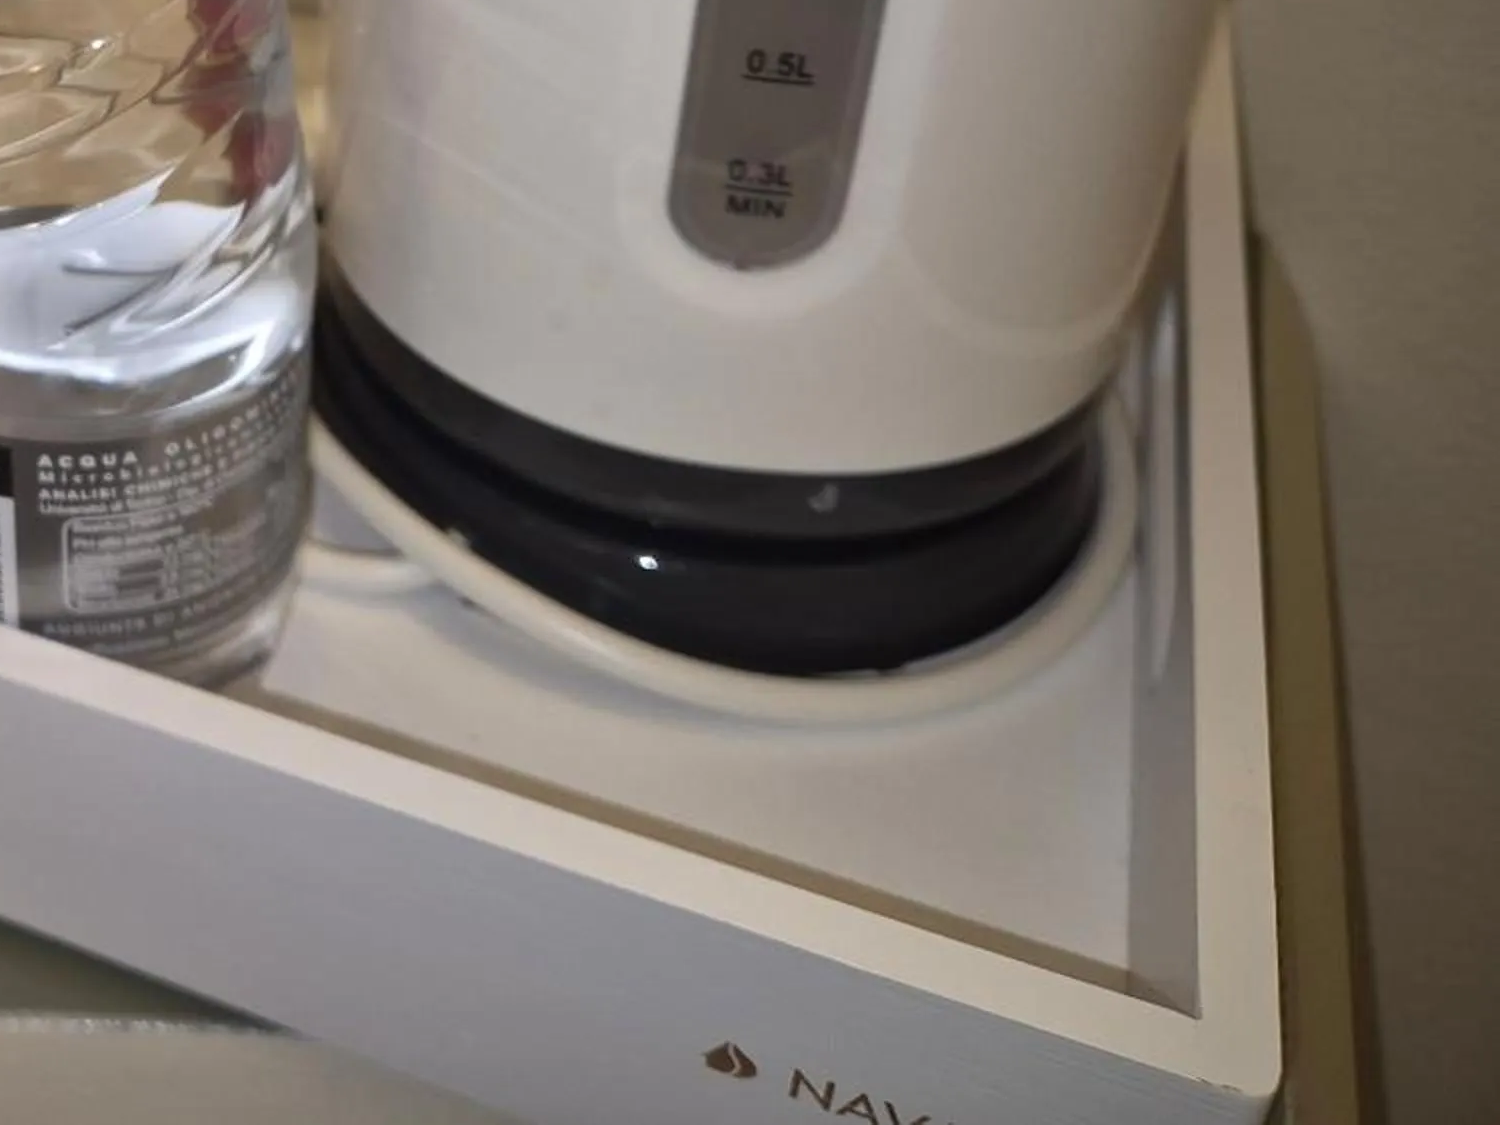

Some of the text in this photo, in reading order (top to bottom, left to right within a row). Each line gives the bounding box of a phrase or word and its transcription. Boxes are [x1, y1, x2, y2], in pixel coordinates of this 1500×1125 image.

[727, 159, 792, 187] 0.3L
[725, 194, 786, 219] MIN
[36, 451, 138, 469] ACQUA
[38, 487, 117, 501] ANALISI
[788, 1068, 954, 1124] NAV
